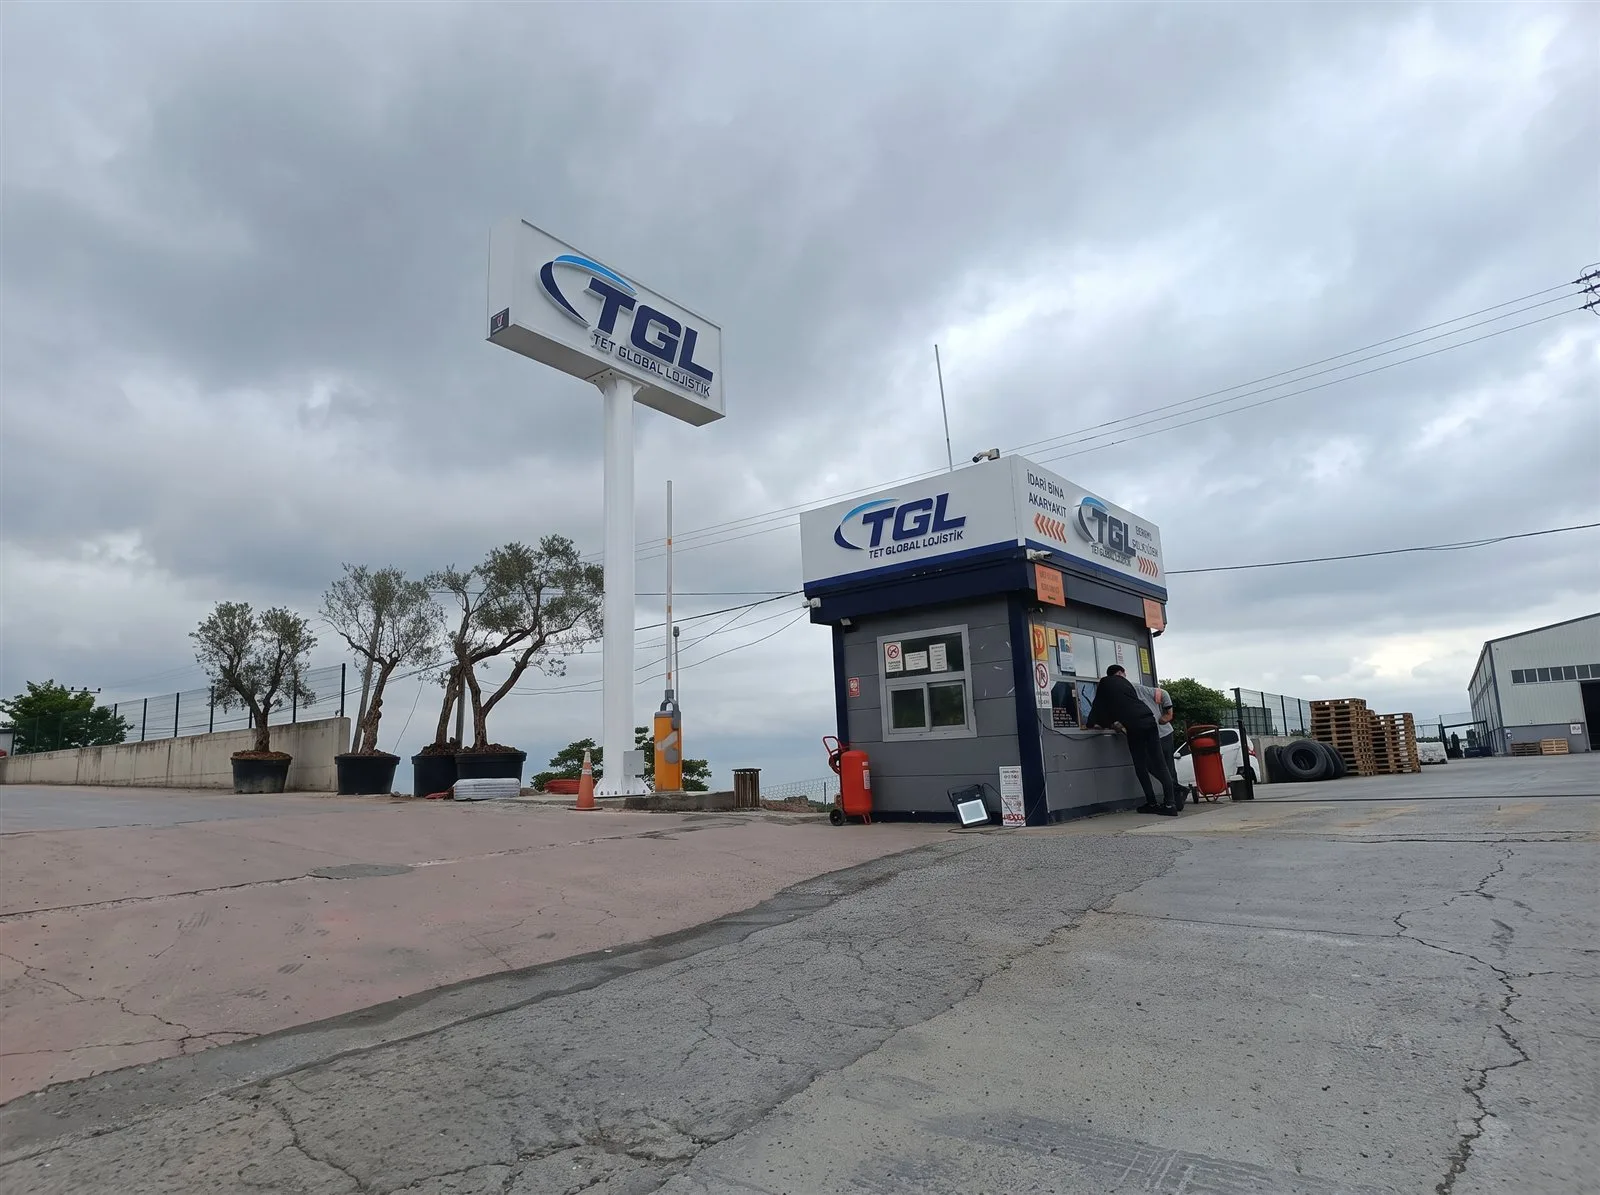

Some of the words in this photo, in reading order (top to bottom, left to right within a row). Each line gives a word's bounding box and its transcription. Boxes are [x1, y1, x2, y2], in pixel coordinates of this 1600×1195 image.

[588, 277, 714, 382] TGL
[593, 333, 616, 352] TET
[618, 346, 663, 375] GLOBAL
[1027, 469, 1047, 491] İDARİ
[1047, 481, 1065, 500] BİNA
[1028, 492, 1067, 518] AKARYAKIT
[862, 493, 966, 547] TGL
[1091, 507, 1137, 558] TGL
[869, 548, 884, 559] TET
[885, 540, 921, 556] GLOBAL
[923, 529, 964, 548] LOJİSTİK
